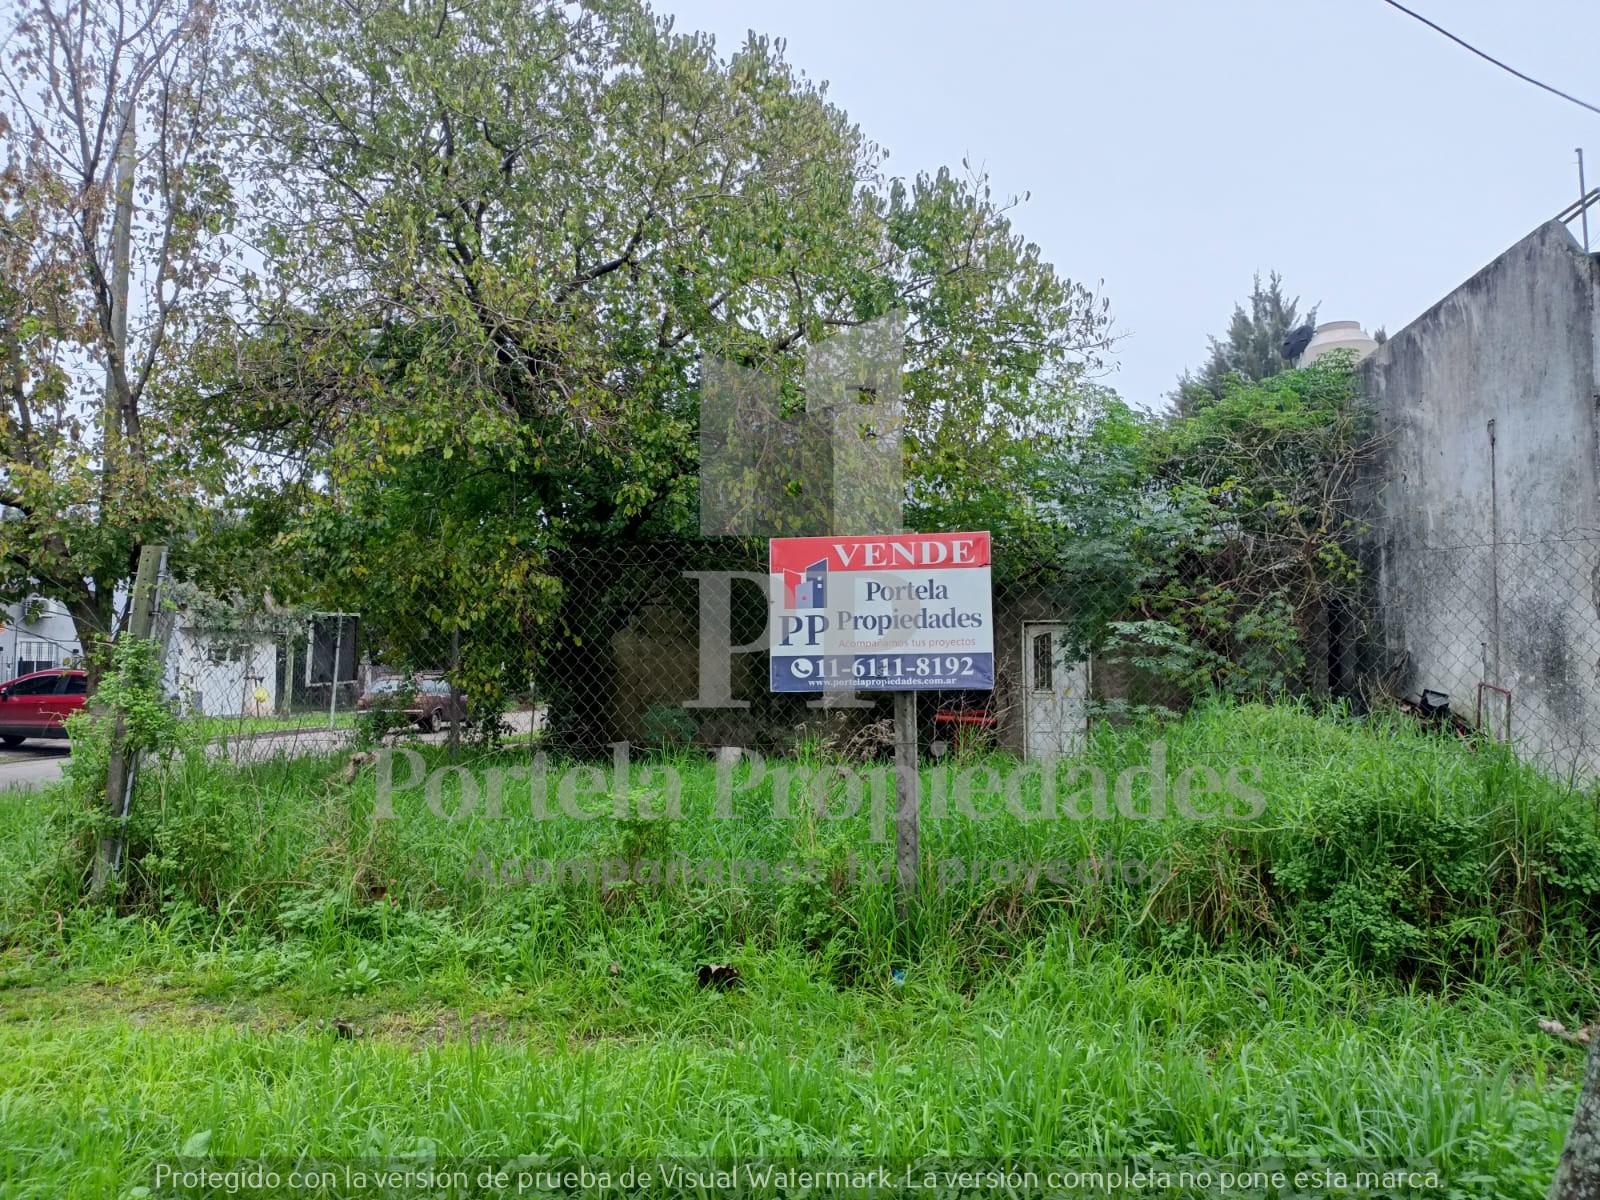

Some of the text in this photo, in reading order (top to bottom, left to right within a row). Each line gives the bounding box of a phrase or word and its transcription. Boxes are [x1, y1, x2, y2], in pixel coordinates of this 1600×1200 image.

[833, 539, 976, 568] VENDE
[865, 578, 949, 602] Portela
[778, 614, 830, 646] PP
[836, 607, 983, 636] Propiedades
[911, 638, 926, 648] tus
[928, 637, 976, 650] proyectos
[815, 656, 975, 678] 11-6111-8192
[808, 676, 957, 689] www.portelapropiedades.com.ar
